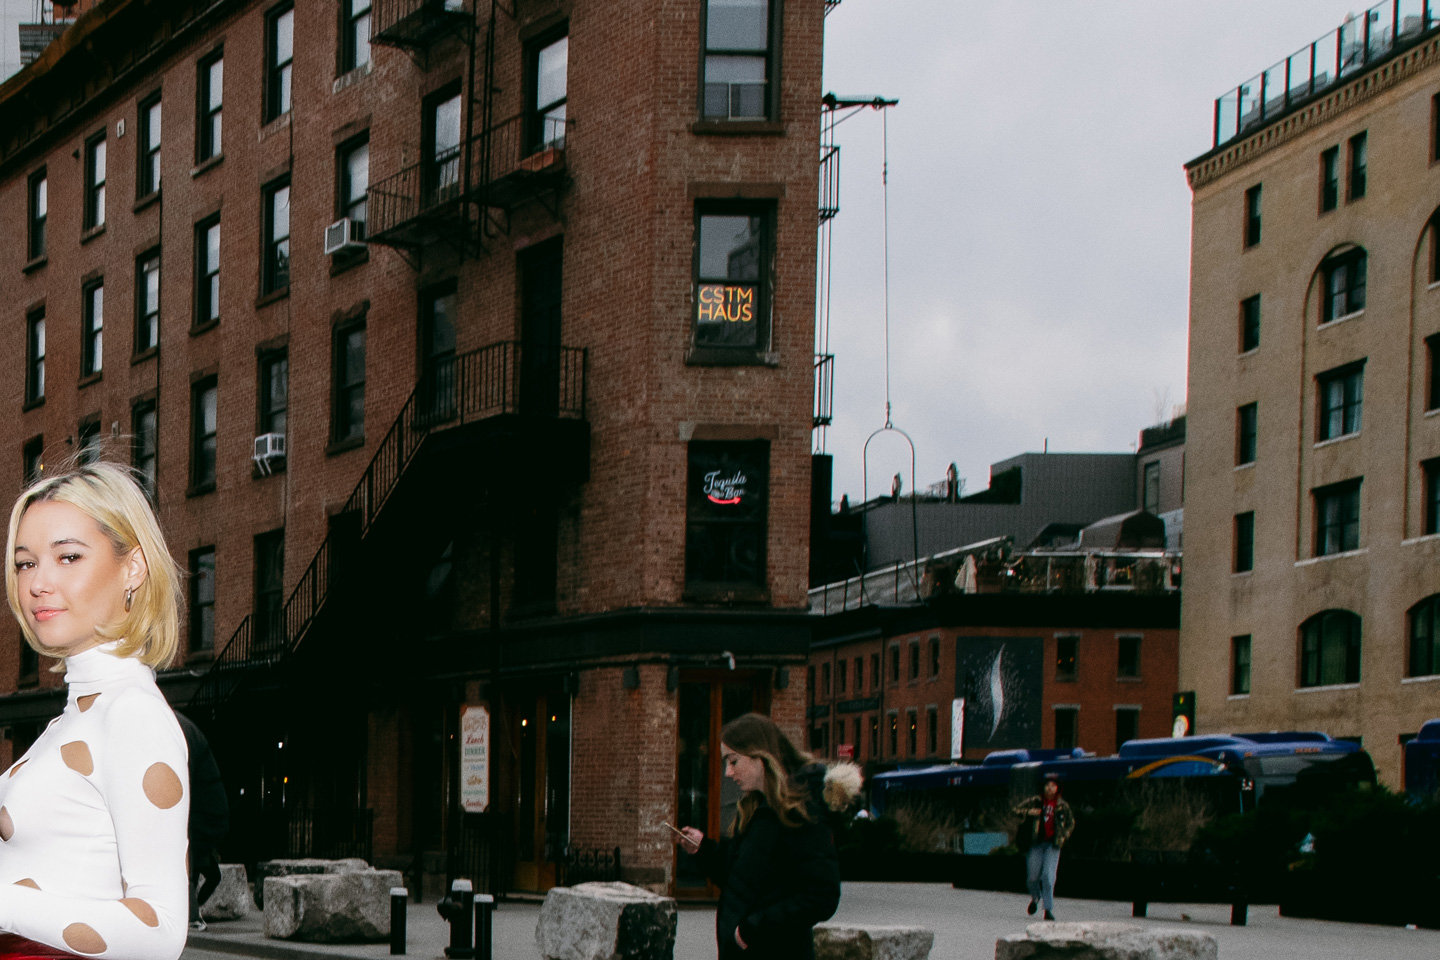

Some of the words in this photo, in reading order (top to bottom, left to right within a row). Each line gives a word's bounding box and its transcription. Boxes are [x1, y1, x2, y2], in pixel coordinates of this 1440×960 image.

[699, 286, 753, 304] CSTM
[698, 303, 753, 322] HAUS
[703, 469, 747, 494] Tequila
[724, 486, 745, 500] Bar
